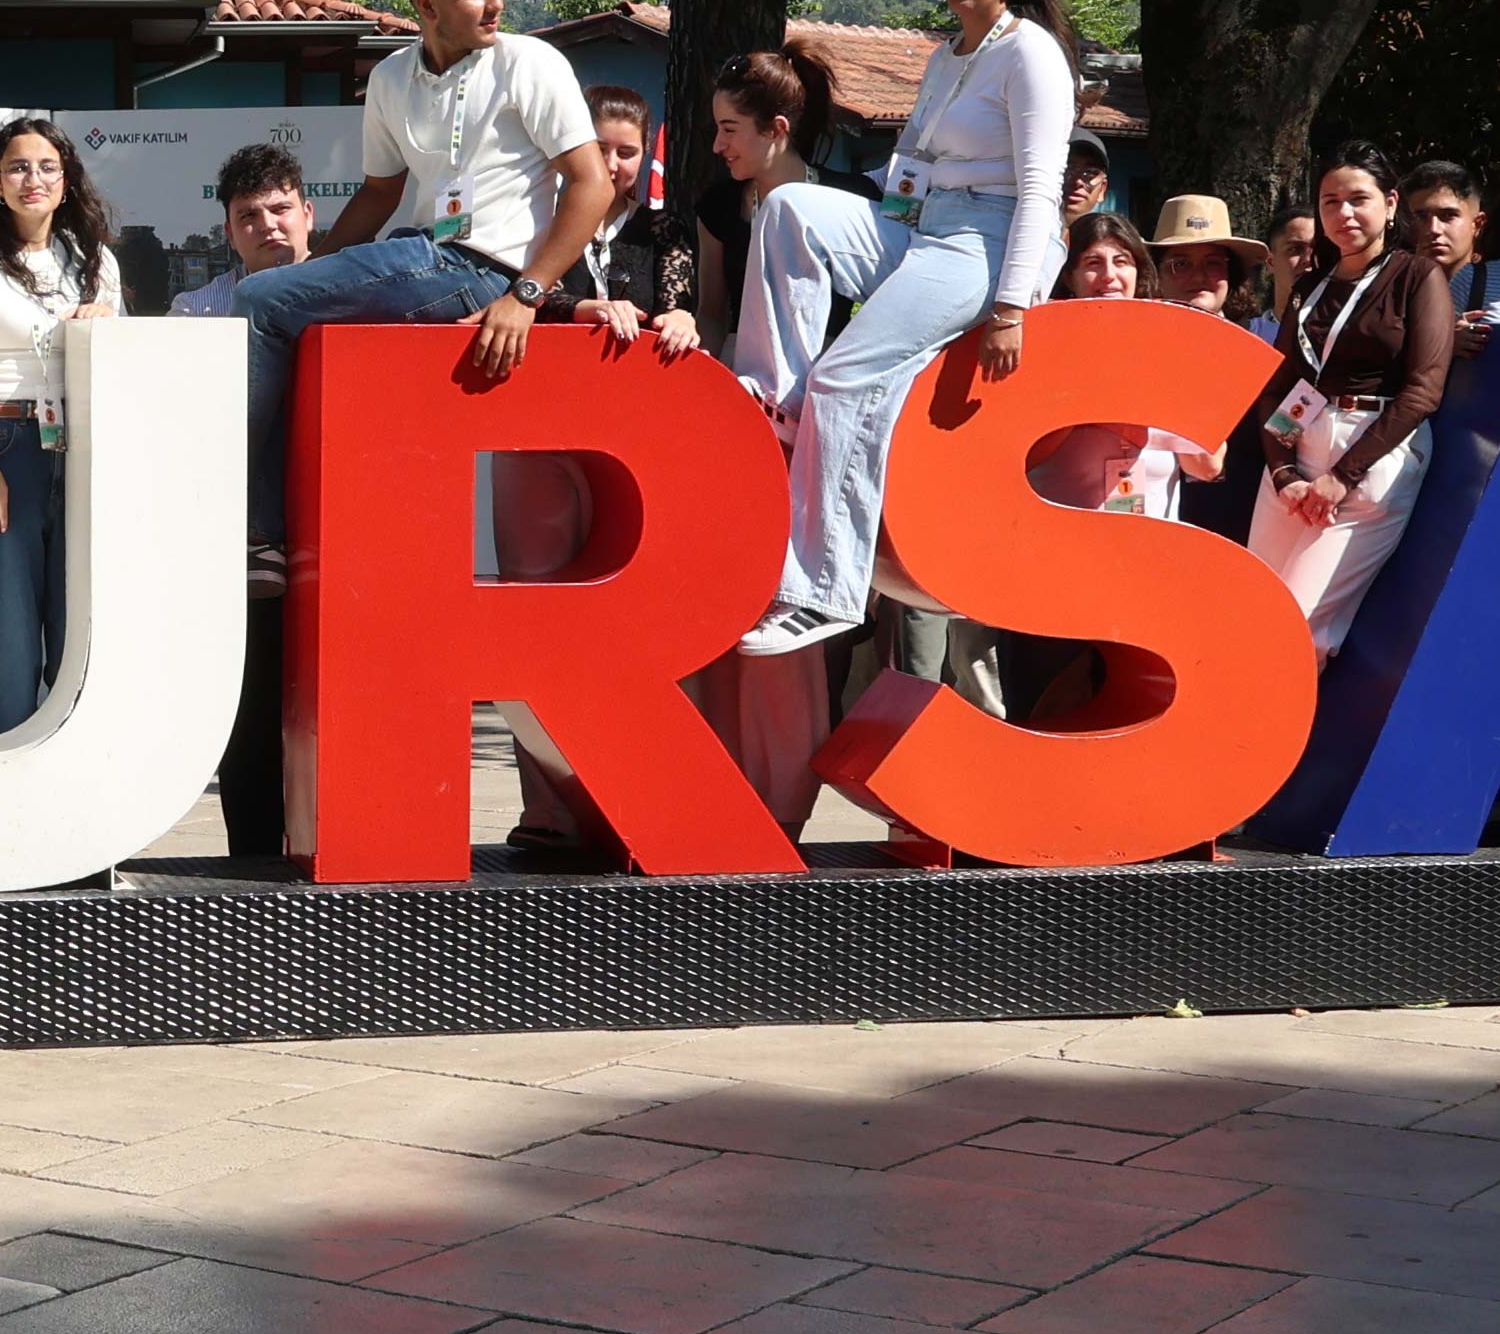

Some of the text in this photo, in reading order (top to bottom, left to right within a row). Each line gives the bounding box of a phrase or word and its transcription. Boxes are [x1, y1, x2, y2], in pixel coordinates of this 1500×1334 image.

[109, 133, 188, 144] VAKIF KATILIM
[270, 128, 302, 144] 700
